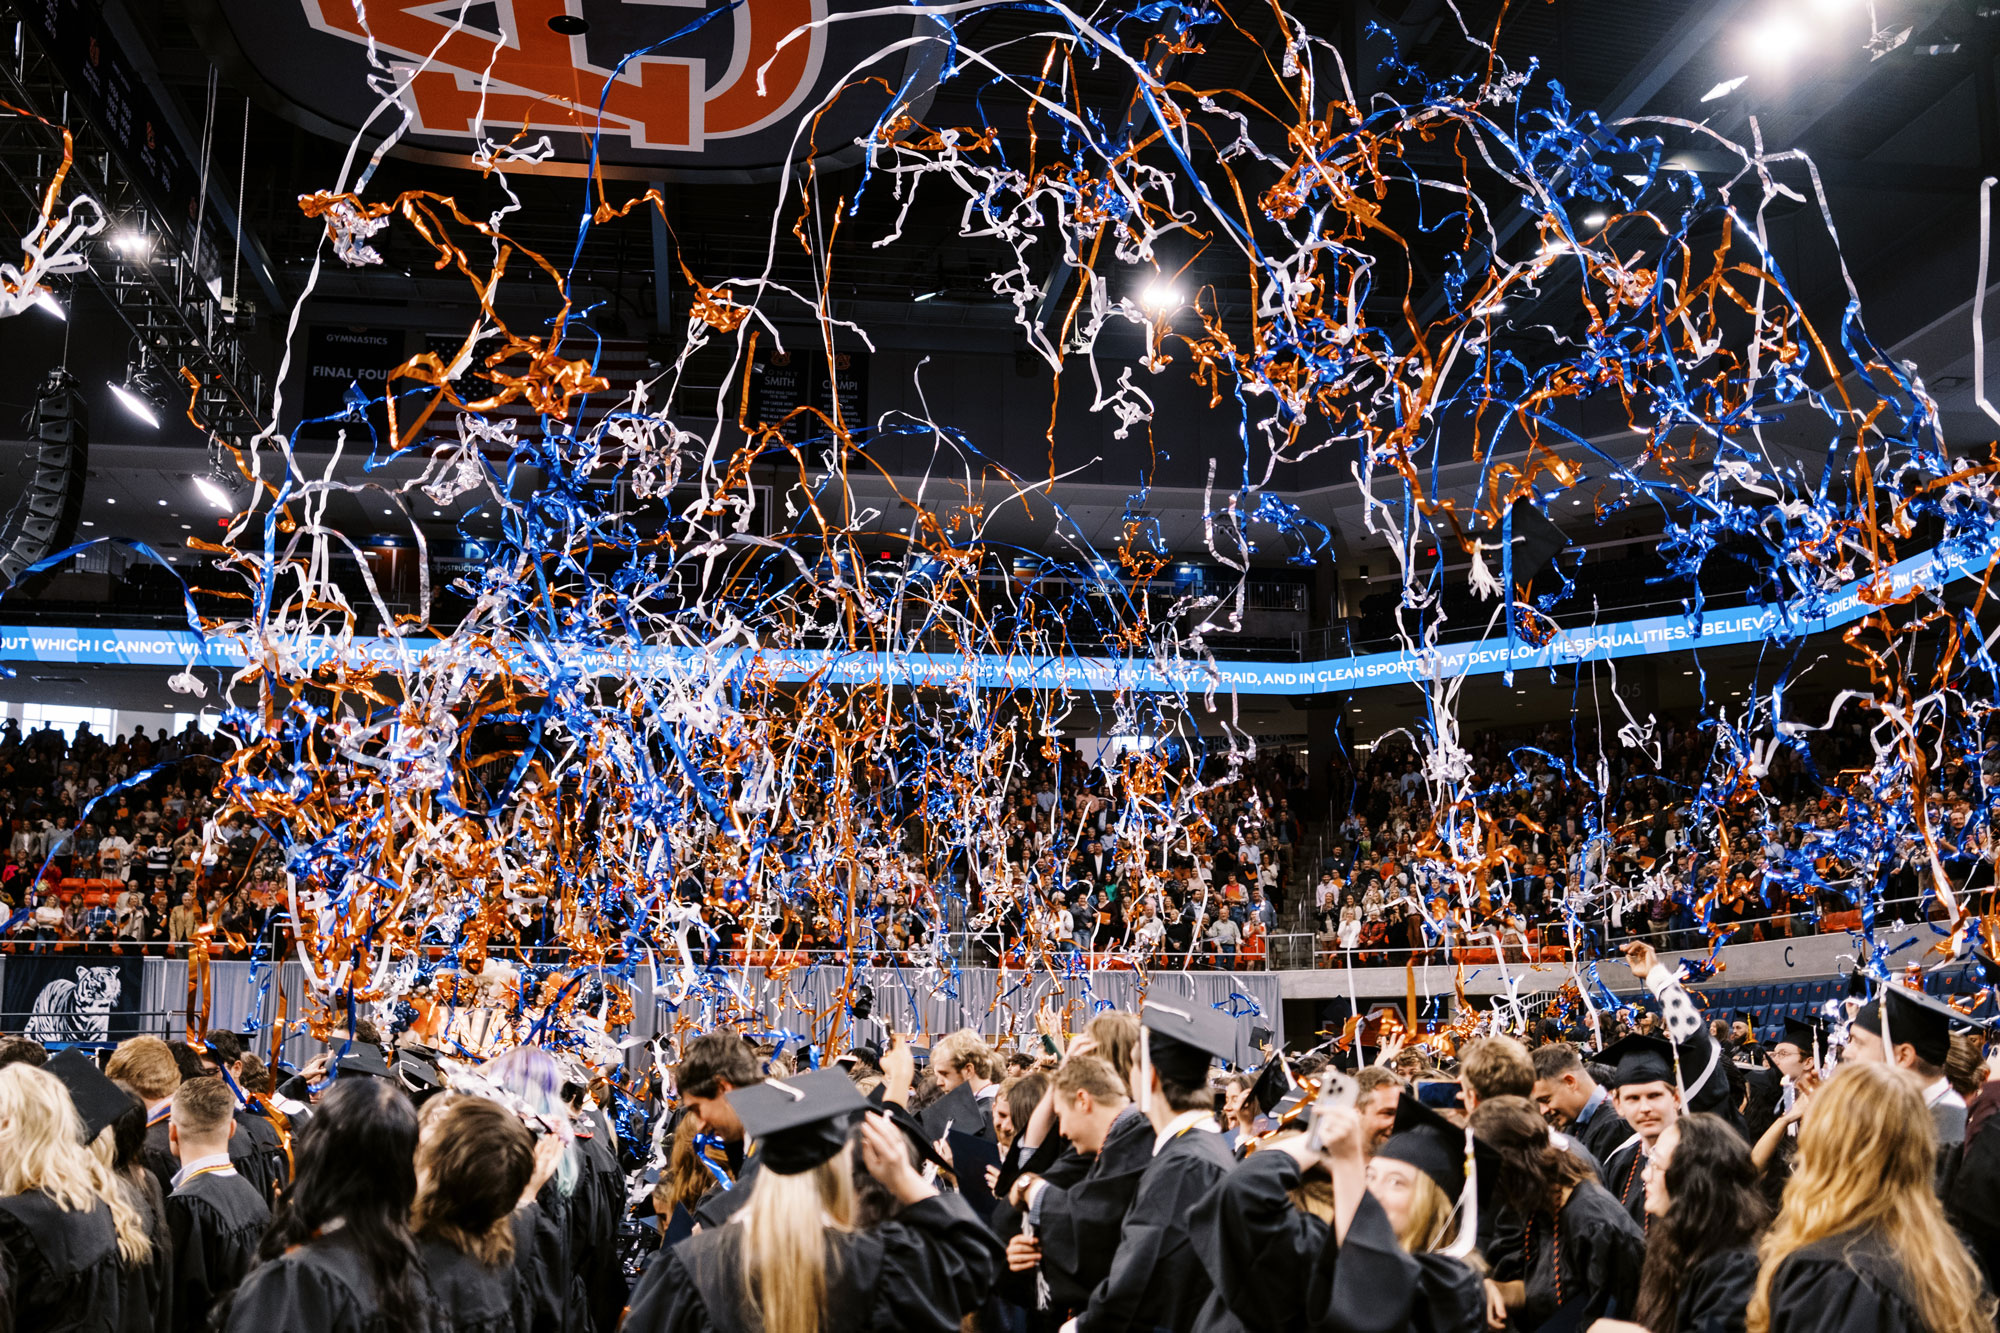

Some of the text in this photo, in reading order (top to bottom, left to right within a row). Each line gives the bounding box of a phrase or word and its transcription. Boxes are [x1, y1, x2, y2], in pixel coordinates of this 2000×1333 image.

[325, 333, 388, 346] GYMNASTICS
[312, 364, 391, 380] FINAL FOU
[764, 376, 796, 387] SMITH
[31, 637, 90, 652] WHICH
[95, 640, 99, 652] I
[102, 641, 176, 654] CANNOT
[214, 643, 248, 656] THE
[868, 662, 884, 674] IN
[1263, 672, 1297, 685] AND
[1299, 672, 1315, 684] IN
[1317, 667, 1365, 684] CLEAN
[1599, 626, 1690, 648] QUALITIES.
[1784, 945, 1795, 968] C
